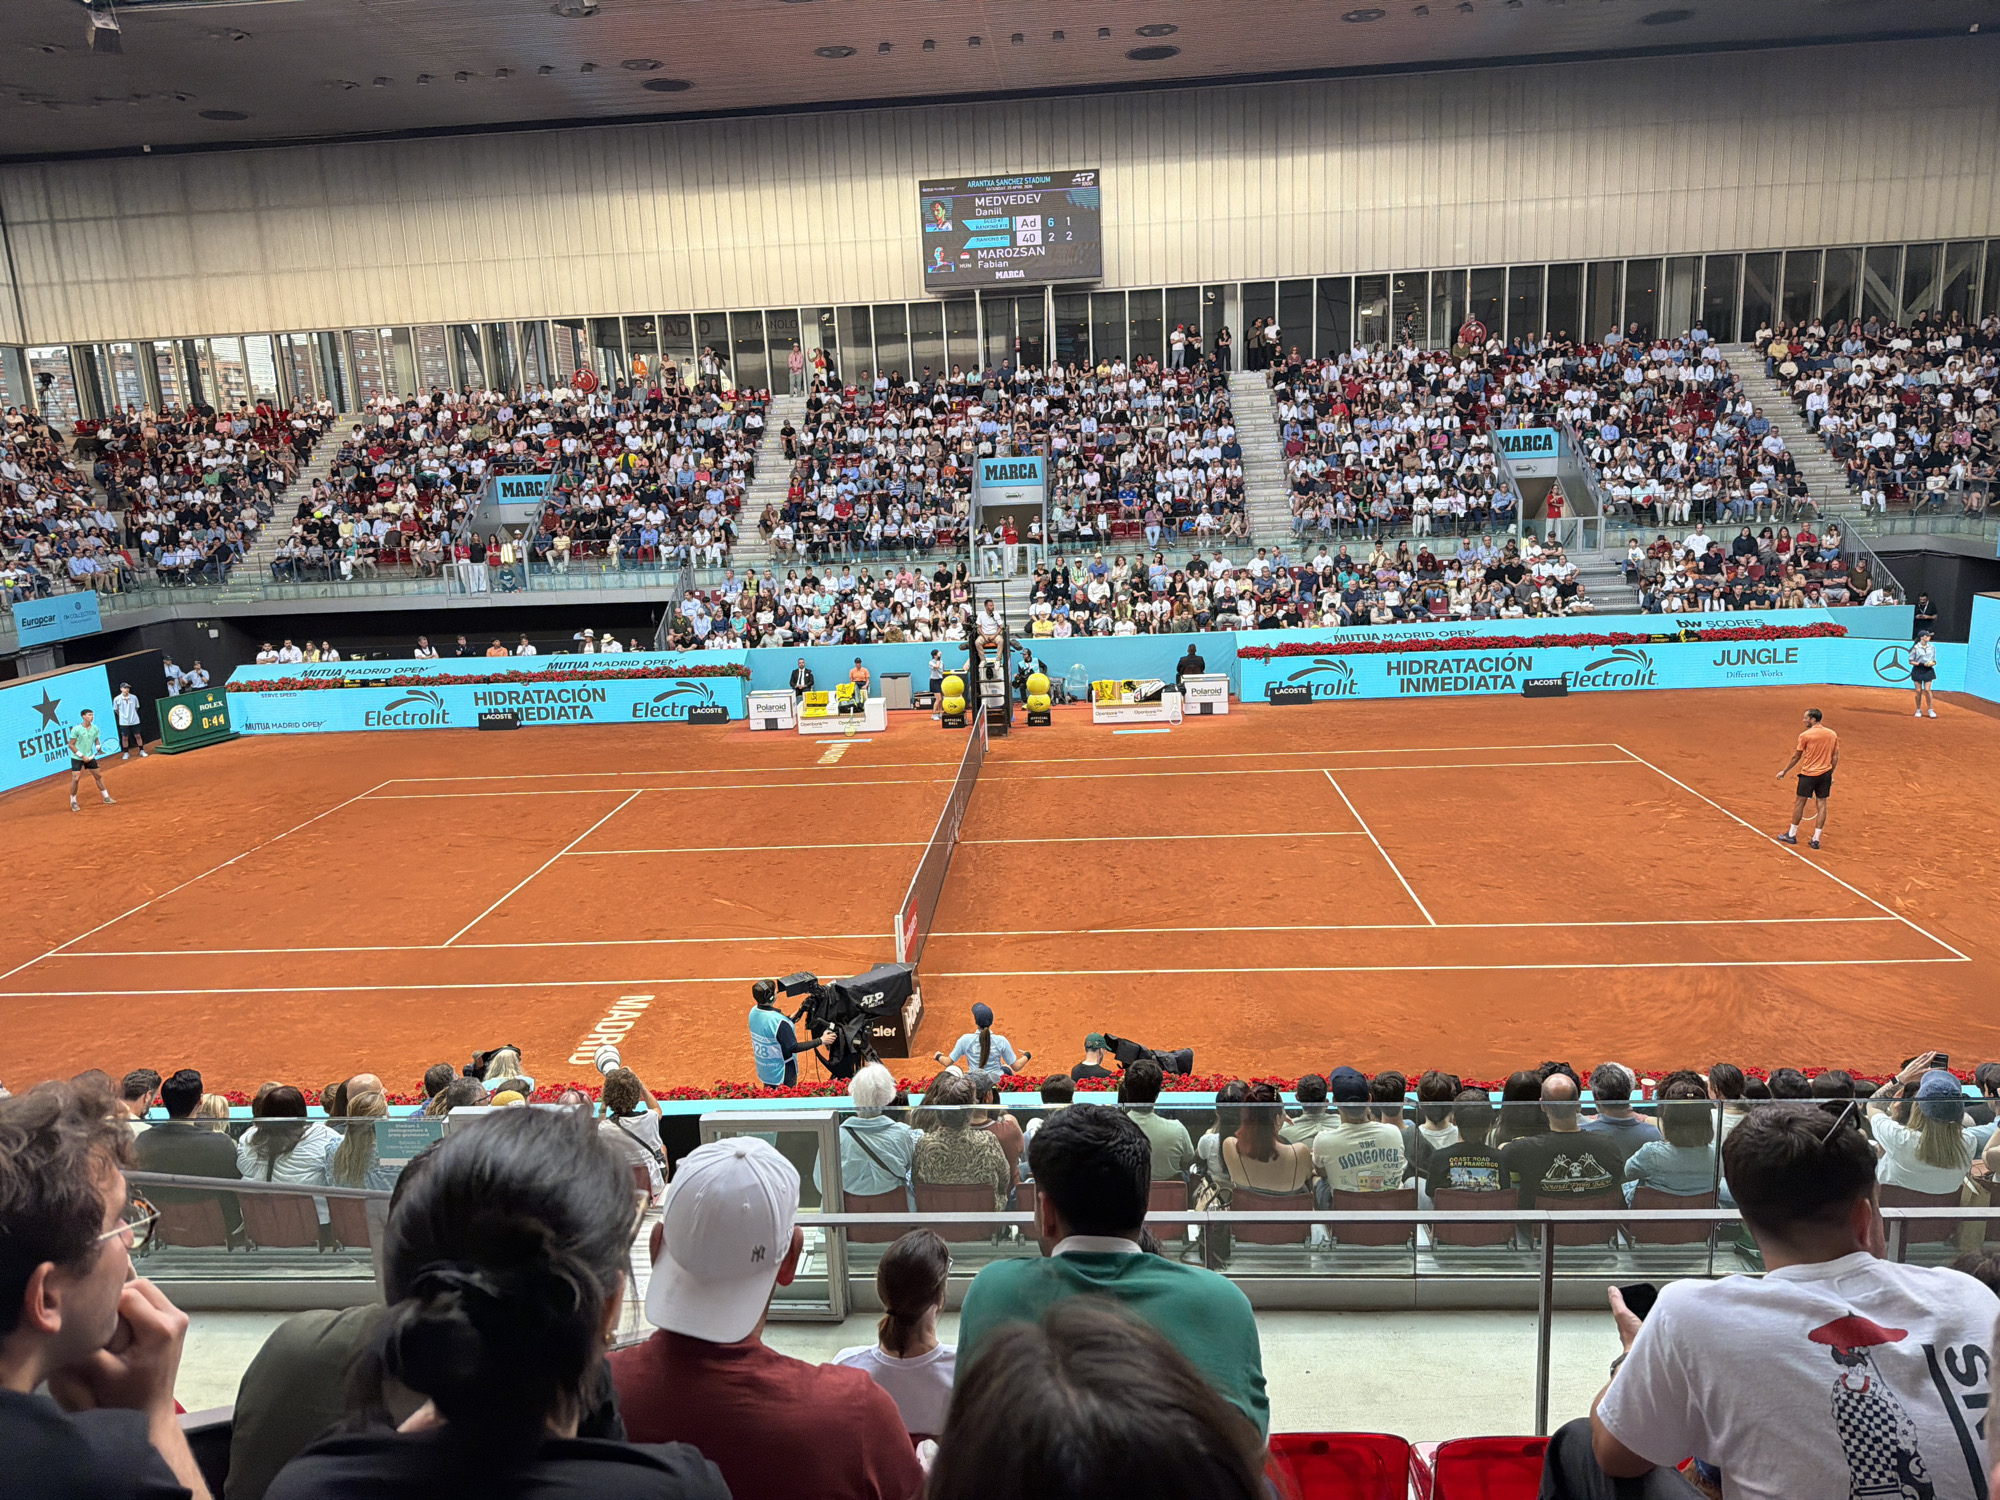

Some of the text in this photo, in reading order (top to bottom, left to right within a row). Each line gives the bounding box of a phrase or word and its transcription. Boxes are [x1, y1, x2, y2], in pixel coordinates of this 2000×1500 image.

[967, 176, 1051, 188] ARANTXA SANCHEZ STADIUM
[1072, 173, 1095, 182] ATP
[975, 194, 1041, 207] MEDVEDEV
[976, 207, 1002, 216] Daniil
[1021, 216, 1070, 228] Ad 6 1
[1022, 231, 1072, 243] 40 2 2
[977, 246, 1045, 259] MAROZSAN
[978, 260, 1009, 268] Fabian
[995, 270, 1025, 279] MARCA
[1498, 434, 1553, 452] MARCA
[985, 463, 1038, 480] MARCA
[21, 614, 56, 627] Europcar
[1706, 618, 1765, 628] SCORES
[1334, 629, 1475, 642] MUTUA MADRID OPEN
[1713, 647, 1799, 667] JUNGLE
[547, 661, 589, 670] MUTUA
[592, 660, 640, 668] MADRID
[1386, 652, 1533, 676] HIDRATACIÓN
[301, 666, 428, 678] MUTUA MADRID OPEN
[1561, 669, 1658, 688] Electrolit
[1726, 670, 1758, 679] Different
[1400, 675, 1516, 693] INMEDIATA
[473, 684, 607, 706] HIDRATACIÓN
[1191, 687, 1222, 695] Polaroid
[1274, 687, 1307, 695] LACOSTE
[199, 700, 224, 711] ROLEX
[756, 703, 786, 711] Polaroid
[202, 713, 225, 729] 0:44
[364, 709, 450, 726] Electrolit
[245, 722, 270, 731] MUTUA
[19, 726, 73, 759] ESTREL
[44, 748, 69, 763] DAMM
[860, 992, 884, 1007] ATP
[568, 995, 656, 1065] MADRID
[872, 1025, 896, 1037] aier
[754, 1043, 769, 1058] 28
[1338, 1148, 1398, 1170] HANGOVER
